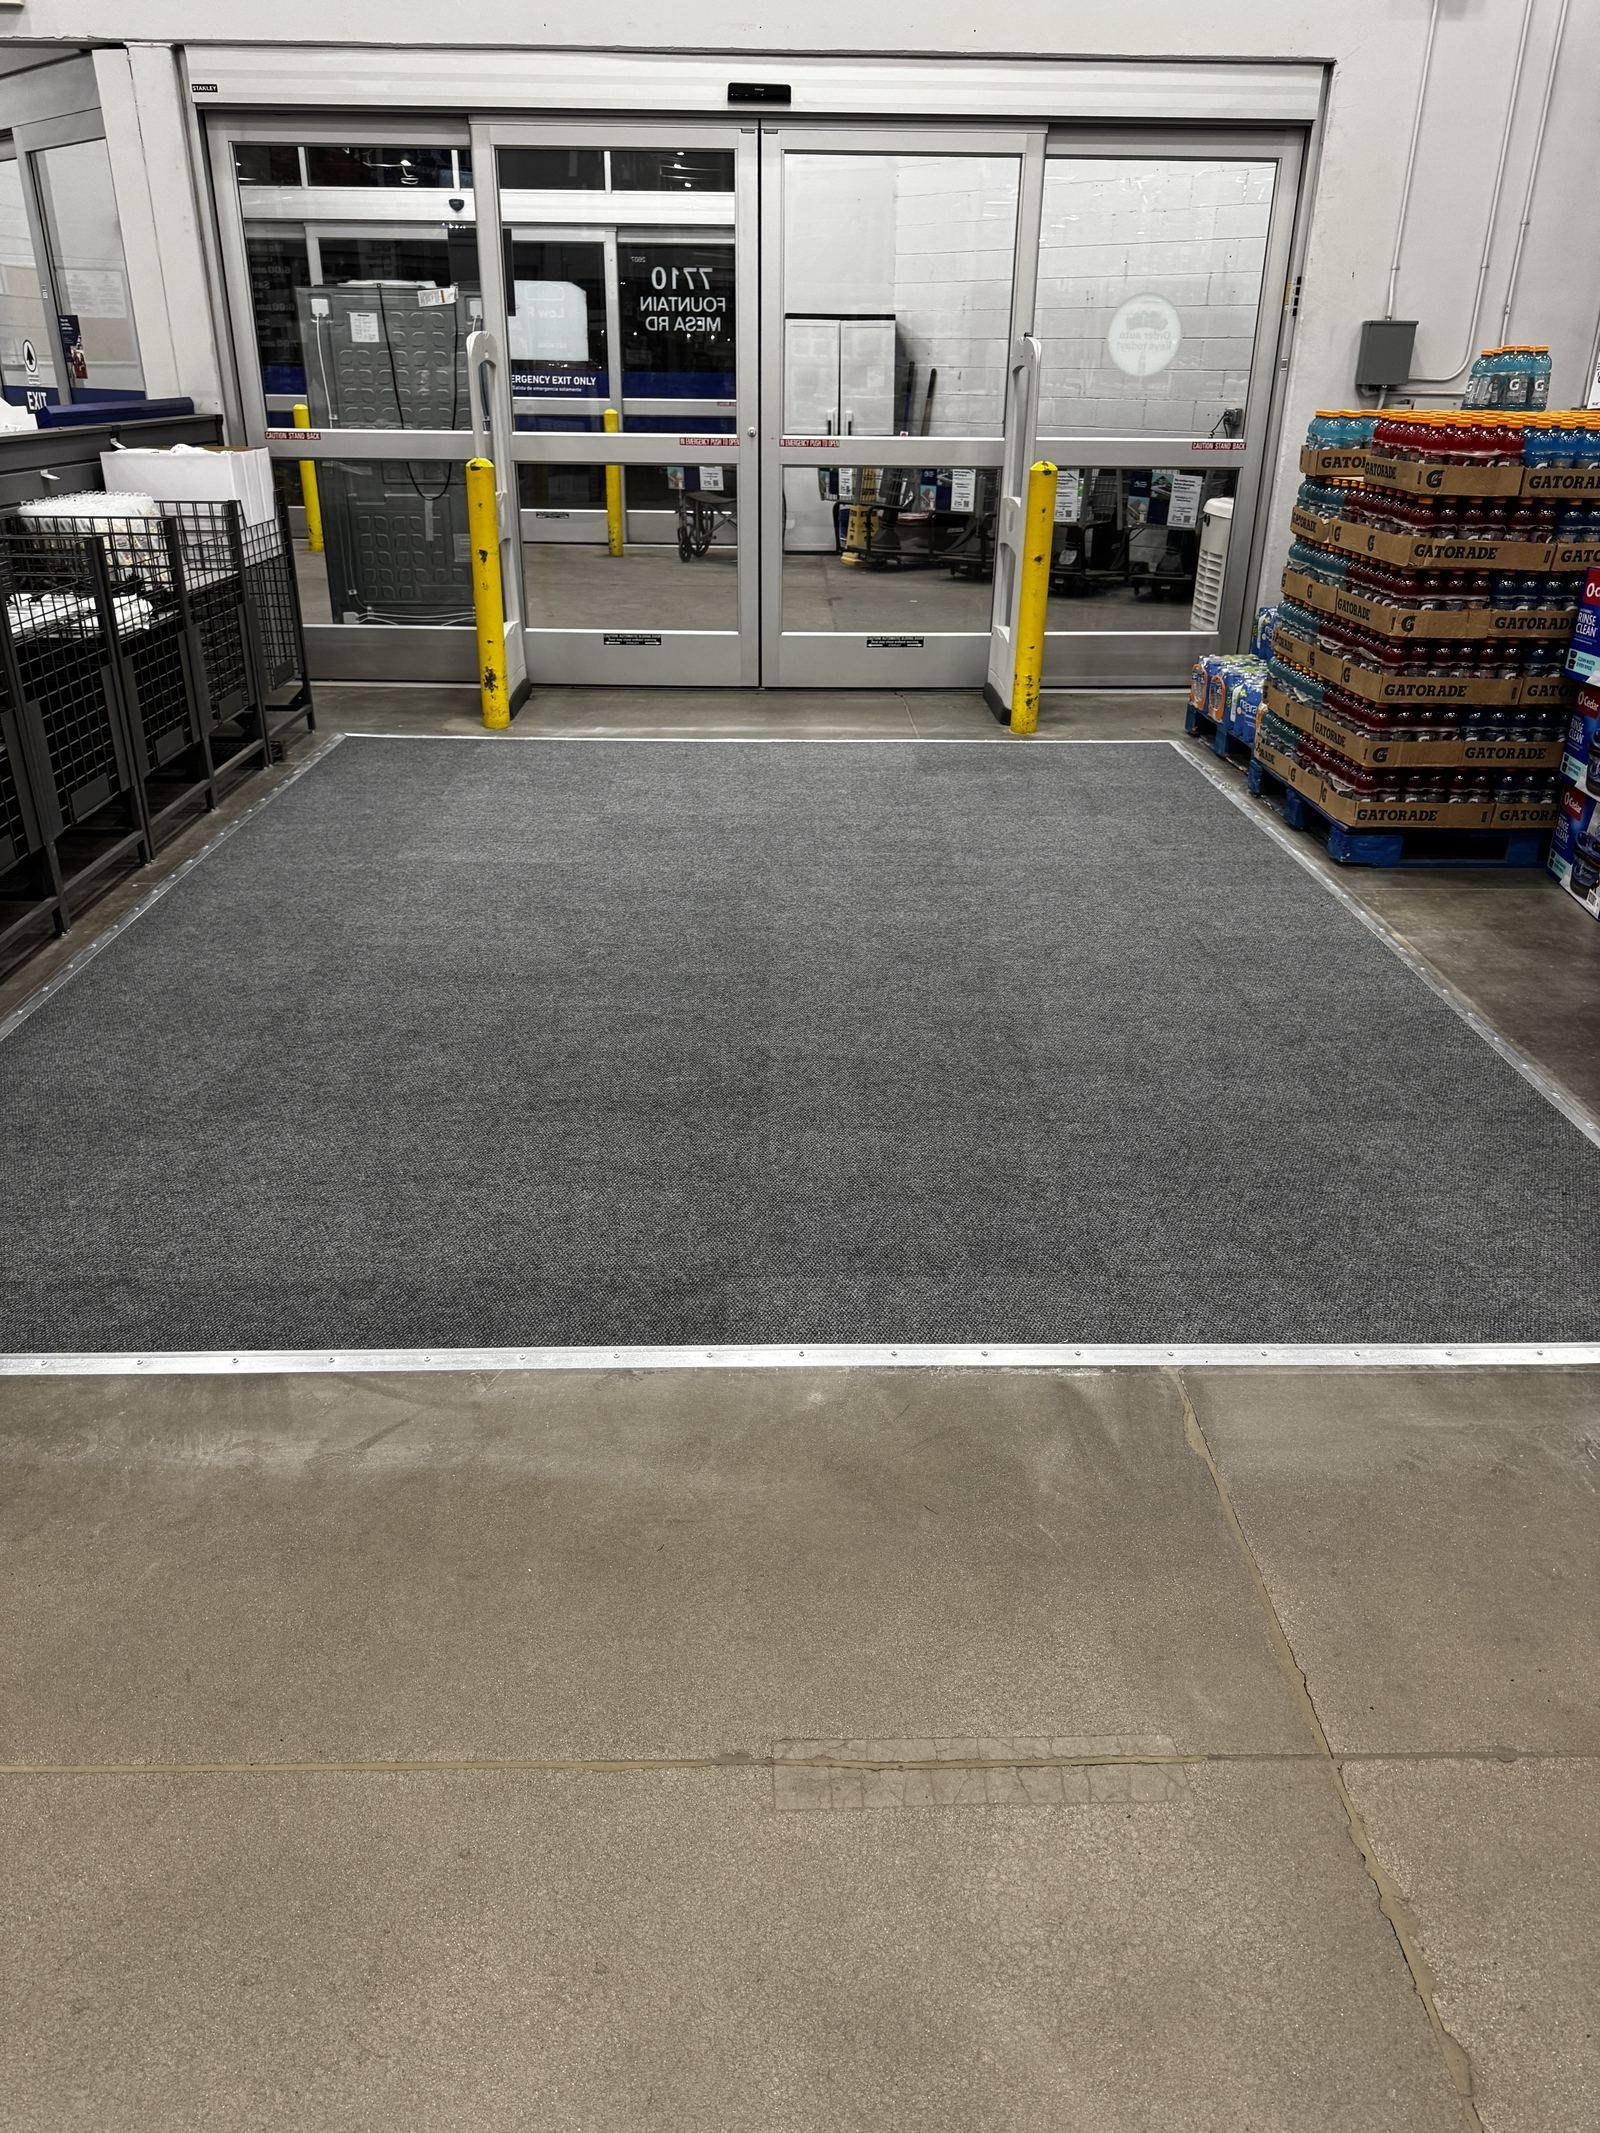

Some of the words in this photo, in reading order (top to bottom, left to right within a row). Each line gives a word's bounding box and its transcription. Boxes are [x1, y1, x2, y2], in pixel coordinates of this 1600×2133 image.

[512, 374, 551, 384] ERGENCY
[552, 376, 572, 385] EXIT
[573, 376, 597, 386] ONLY
[1509, 379, 1520, 391] G
[1534, 379, 1545, 391] G
[26, 391, 47, 410] EXIT
[1214, 442, 1232, 450] STAND
[1322, 457, 1366, 468] GATO
[1365, 462, 1397, 479] GATORADE
[1426, 470, 1445, 488] G
[1529, 476, 1600, 489] GATORA
[1414, 544, 1500, 560] GATORADE
[1561, 551, 1600, 562] GATO
[1337, 598, 1371, 621] GATORADE
[1401, 615, 1417, 632] G
[1495, 617, 1572, 629] GATORAD
[1577, 611, 1597, 627] RINSE
[1575, 622, 1598, 638] CLEAN
[1384, 684, 1468, 697] GATORADE
[1315, 724, 1346, 748] GATORADE
[1465, 747, 1546, 760] GATORADE
[1357, 810, 1439, 821] GATORADE
[1501, 810, 1558, 821] GATORA
